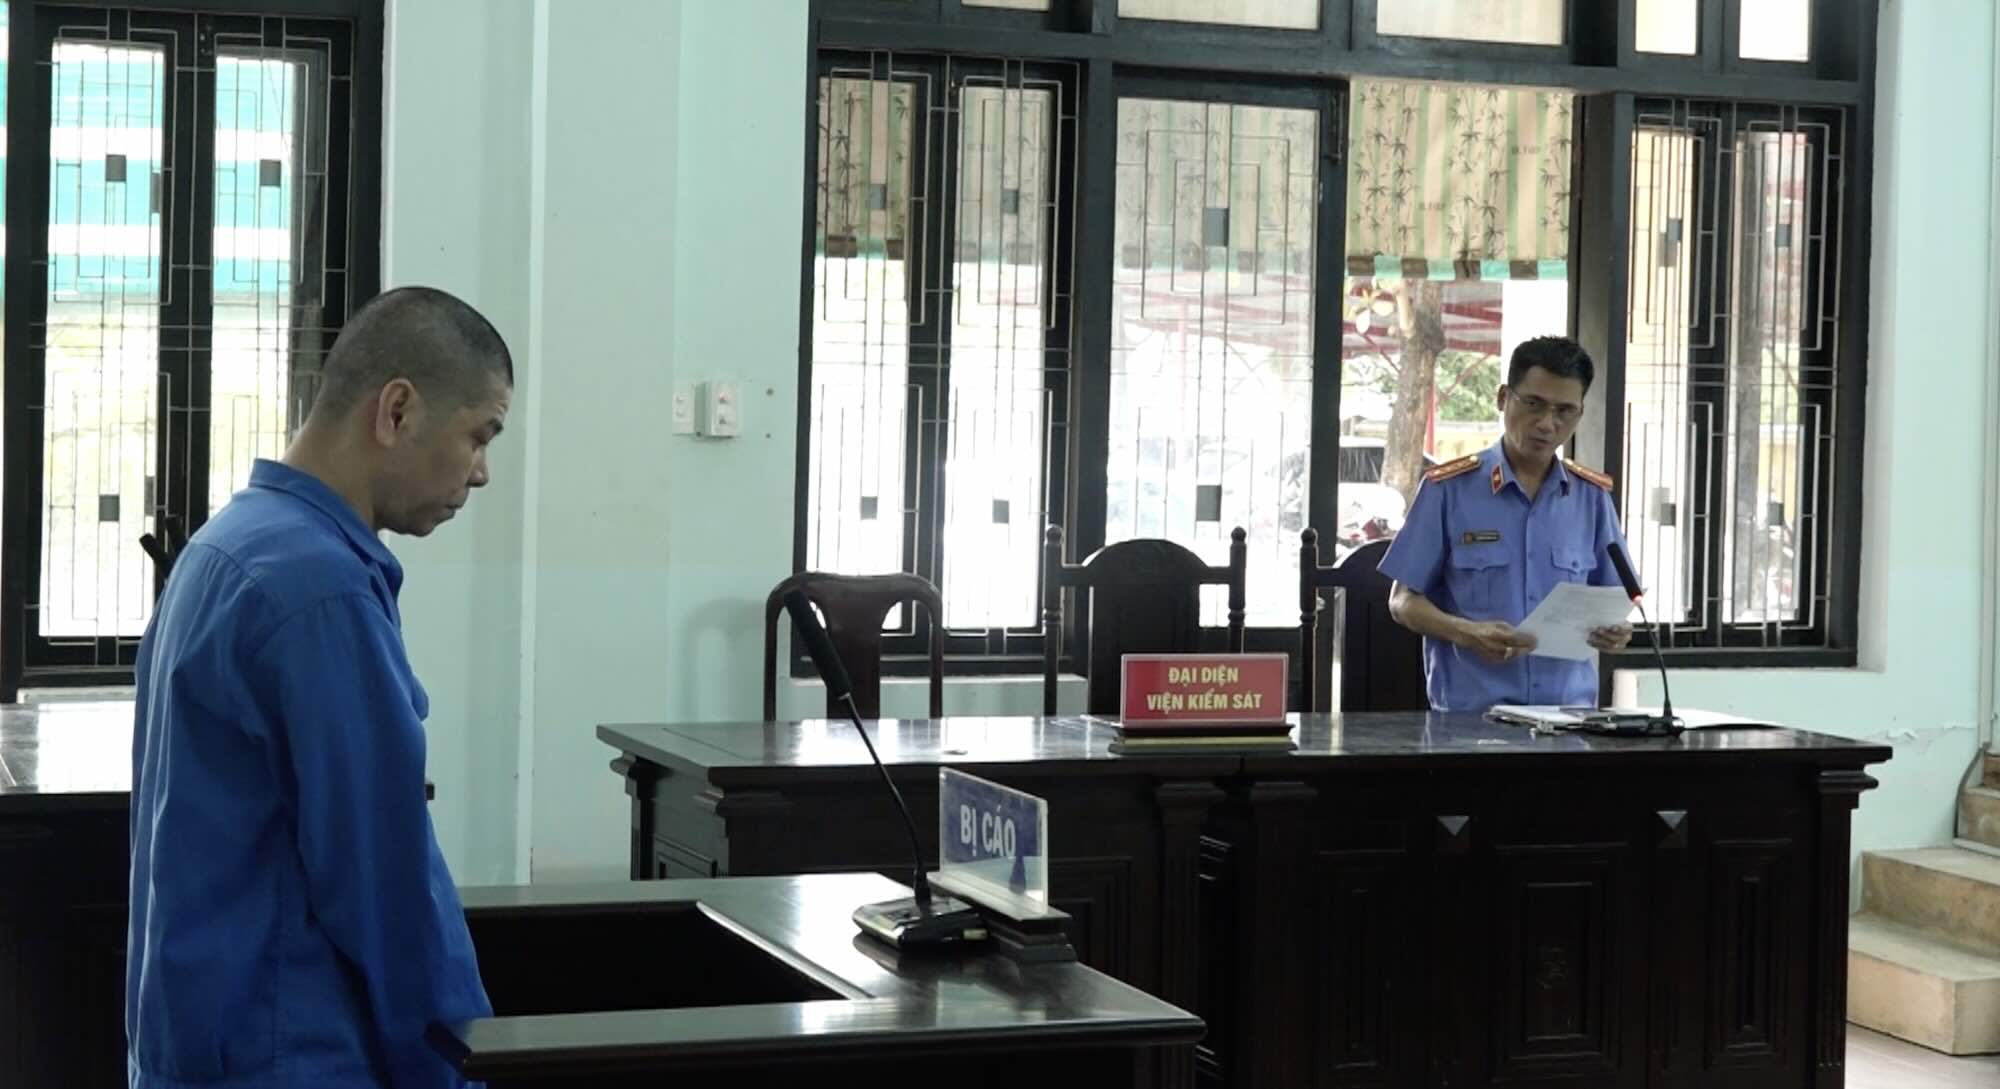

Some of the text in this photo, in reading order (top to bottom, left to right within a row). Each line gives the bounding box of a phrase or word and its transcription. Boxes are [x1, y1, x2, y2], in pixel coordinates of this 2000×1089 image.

[1168, 664, 1238, 687] ĐẠI DIỆN
[1147, 692, 1183, 714] VIỆN
[1232, 690, 1263, 709] SÁT
[960, 804, 1017, 860] BỊ CÁO
